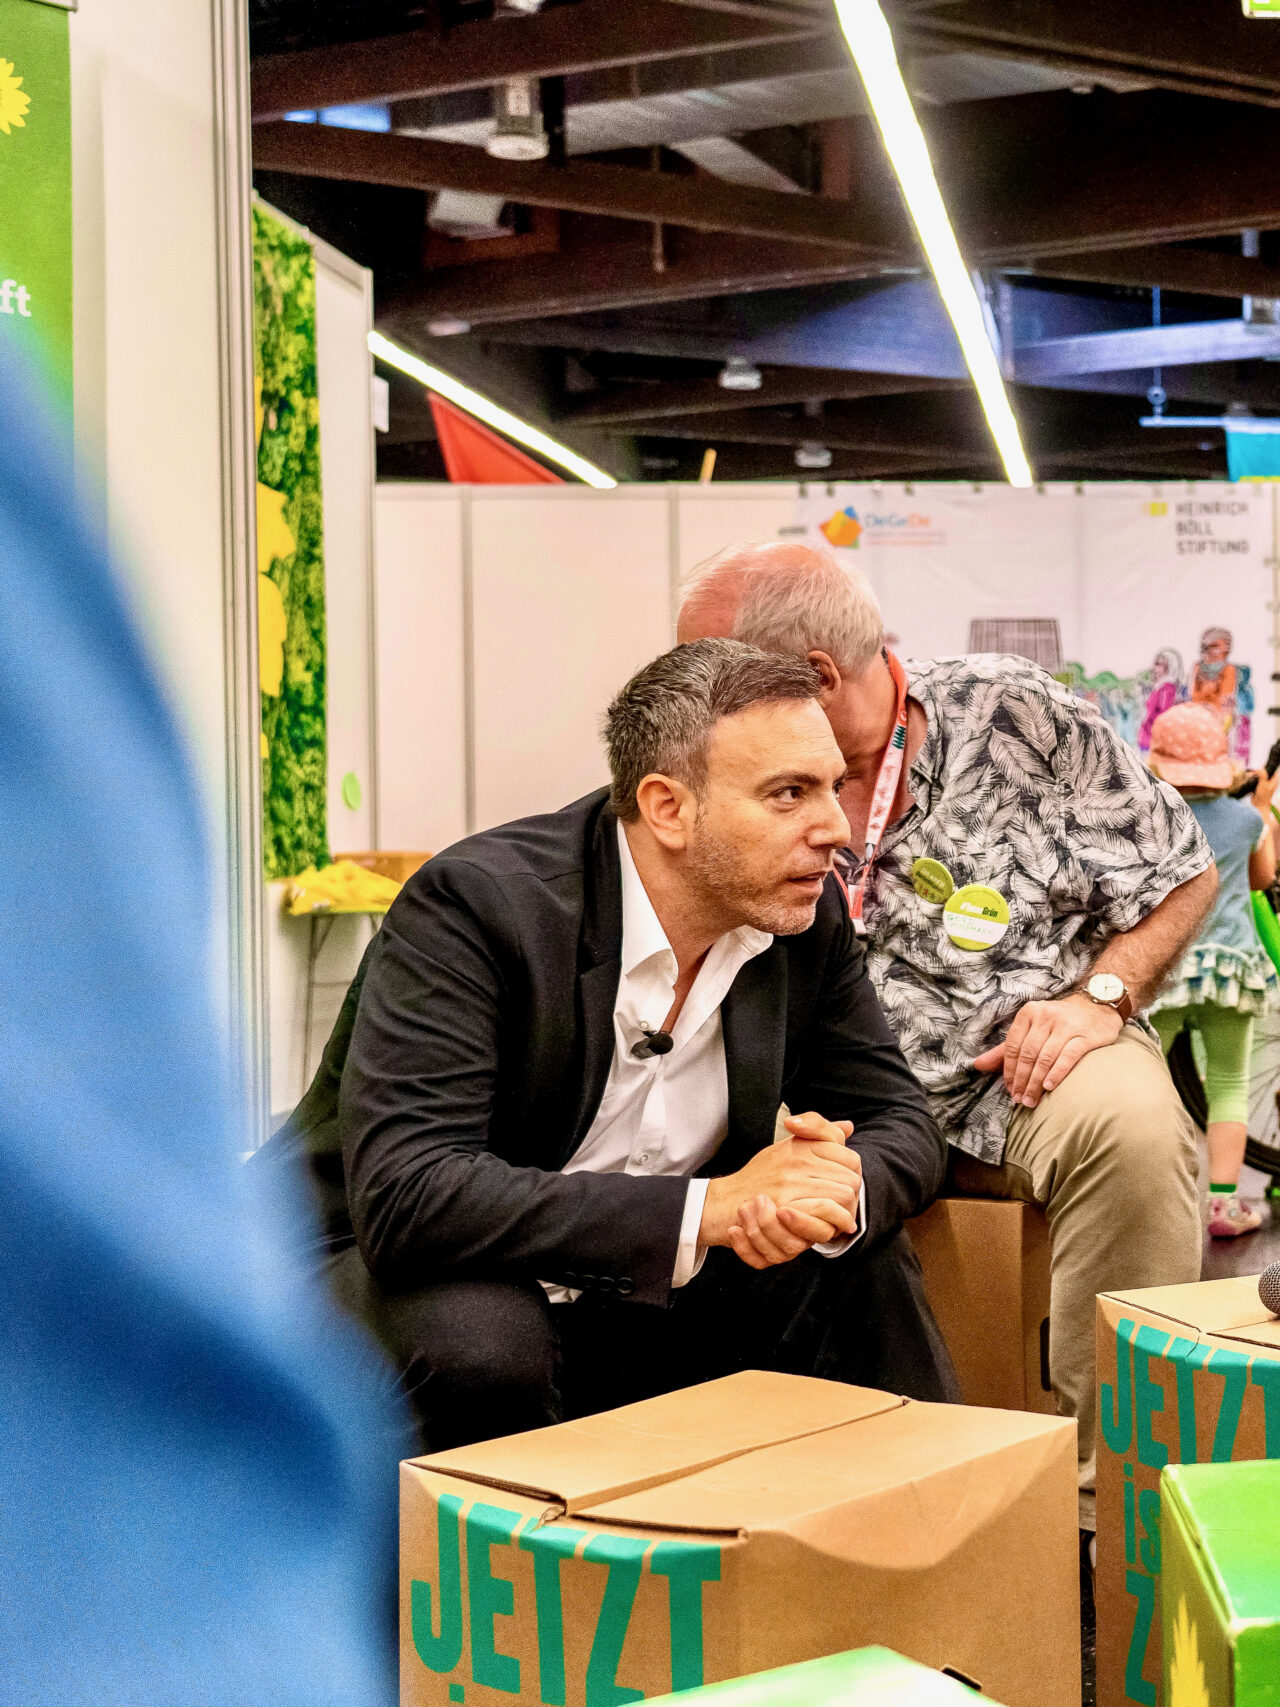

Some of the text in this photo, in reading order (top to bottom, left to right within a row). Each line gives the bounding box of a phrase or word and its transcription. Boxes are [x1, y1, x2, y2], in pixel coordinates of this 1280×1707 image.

[1175, 502, 1249, 516] HEINRICH
[1175, 519, 1213, 536] BÖLL
[1175, 540, 1250, 555] STIFTUNG
[411, 1493, 720, 1707] JETZT
